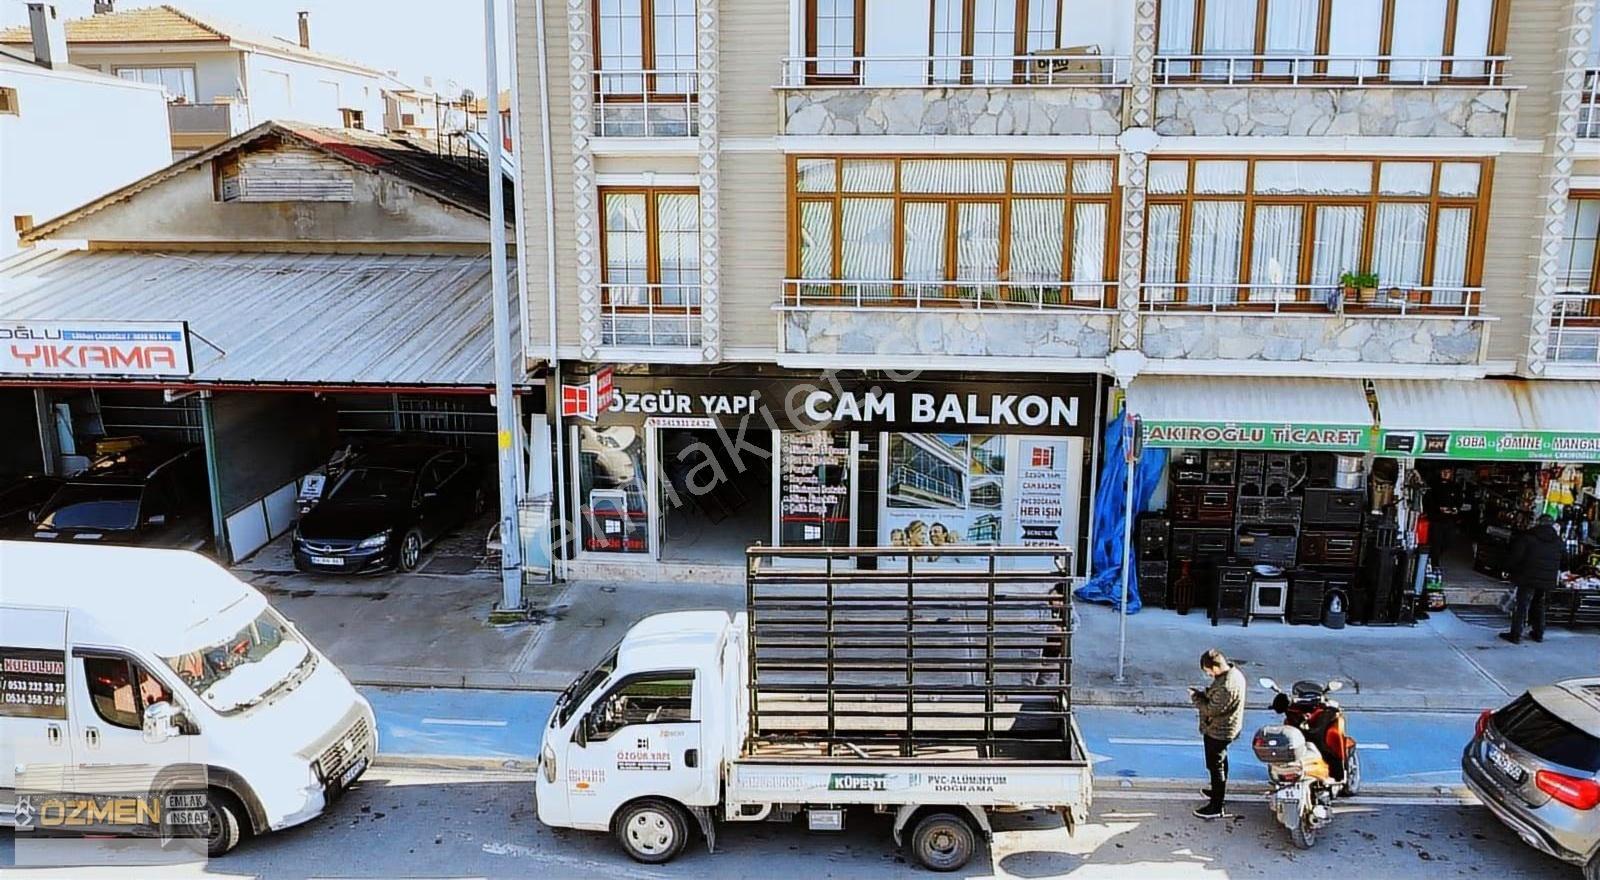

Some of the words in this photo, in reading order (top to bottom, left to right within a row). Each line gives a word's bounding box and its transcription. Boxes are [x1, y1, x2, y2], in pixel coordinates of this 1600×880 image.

[11, 345, 176, 368] YIKAMA
[700, 395, 755, 414] YAPI
[804, 391, 896, 422] CAM
[911, 393, 1079, 426] BALKON
[1272, 424, 1362, 445] TİCARET
[1456, 436, 1486, 447] SOBA
[1020, 507, 1040, 516] HER
[4, 659, 64, 674] KURULUM
